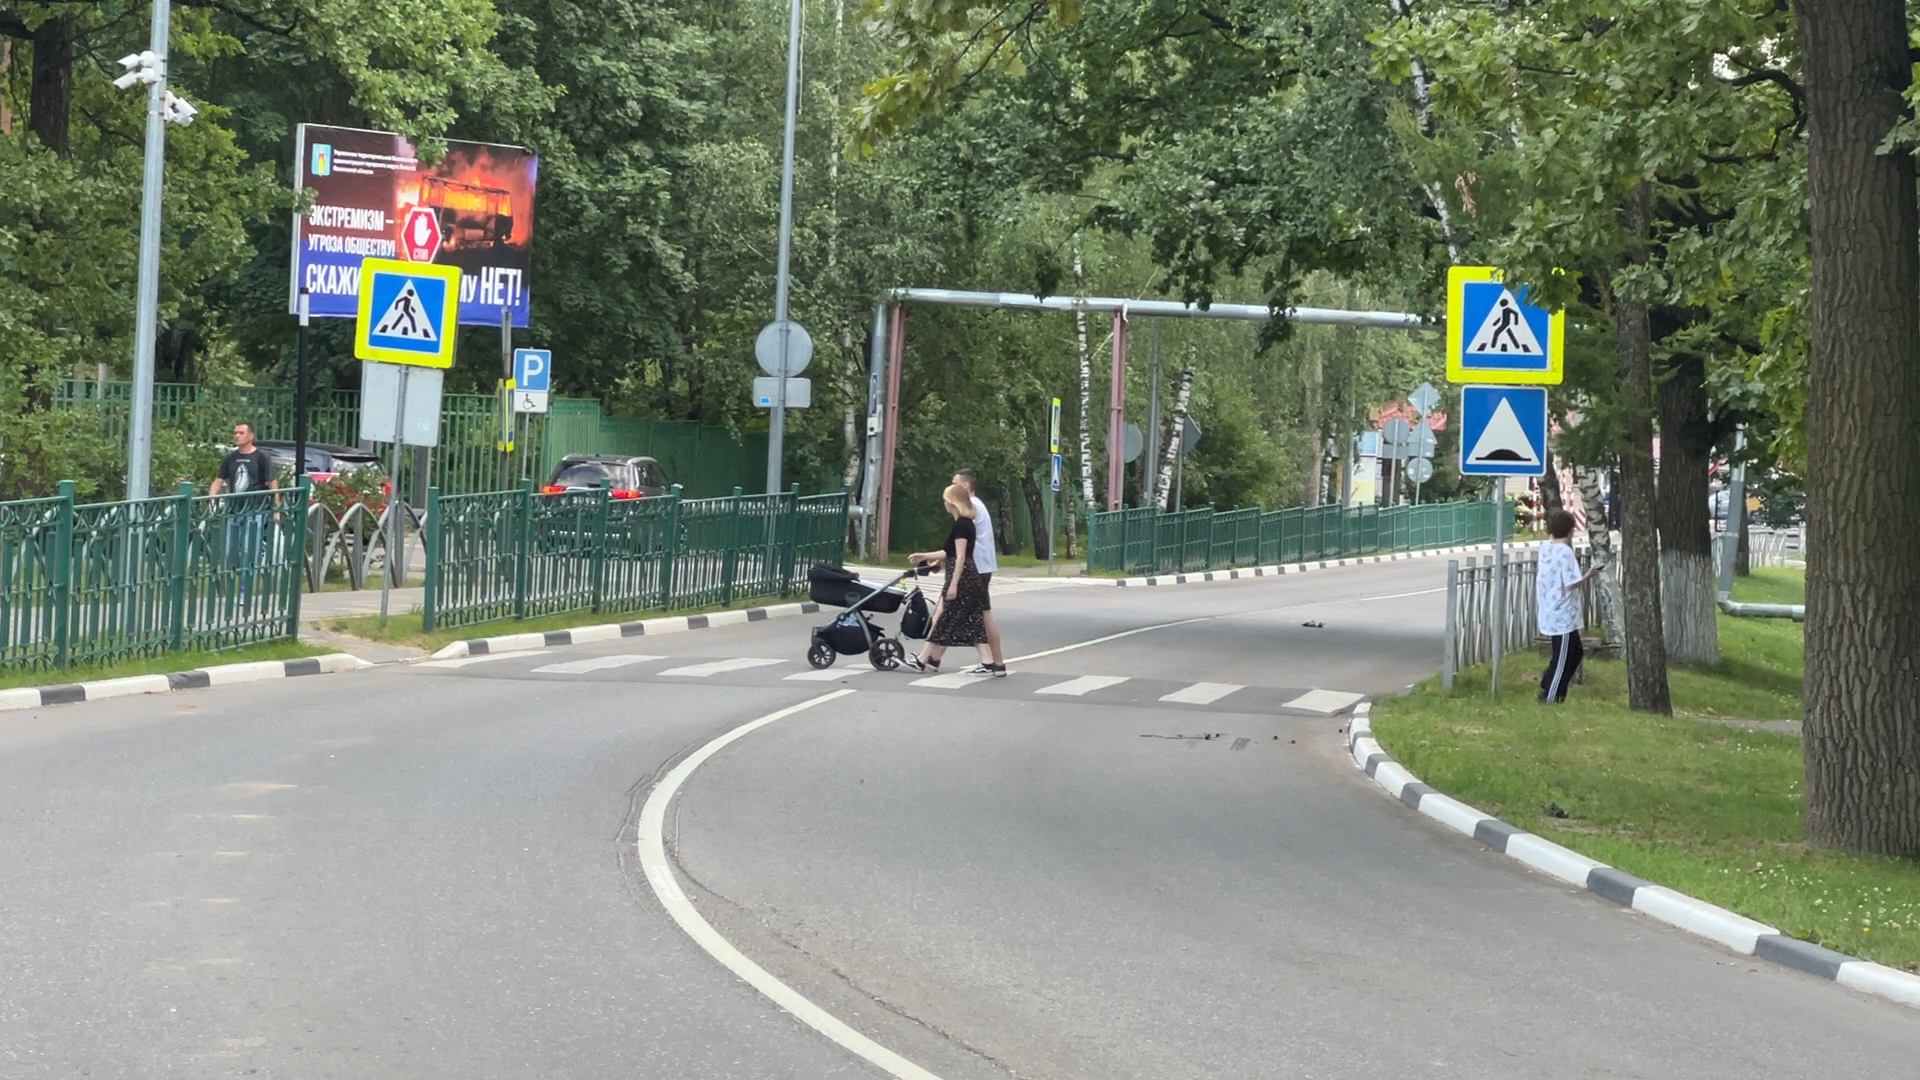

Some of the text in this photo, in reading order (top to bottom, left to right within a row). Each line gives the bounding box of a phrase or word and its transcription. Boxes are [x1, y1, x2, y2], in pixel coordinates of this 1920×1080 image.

[309, 205, 384, 231] ЭКСТРЕМИЗМ
[308, 233, 396, 257] УГРОЗА ОБЩЕСТВУ!
[480, 266, 522, 306] НЕТ!
[523, 354, 544, 387] P
